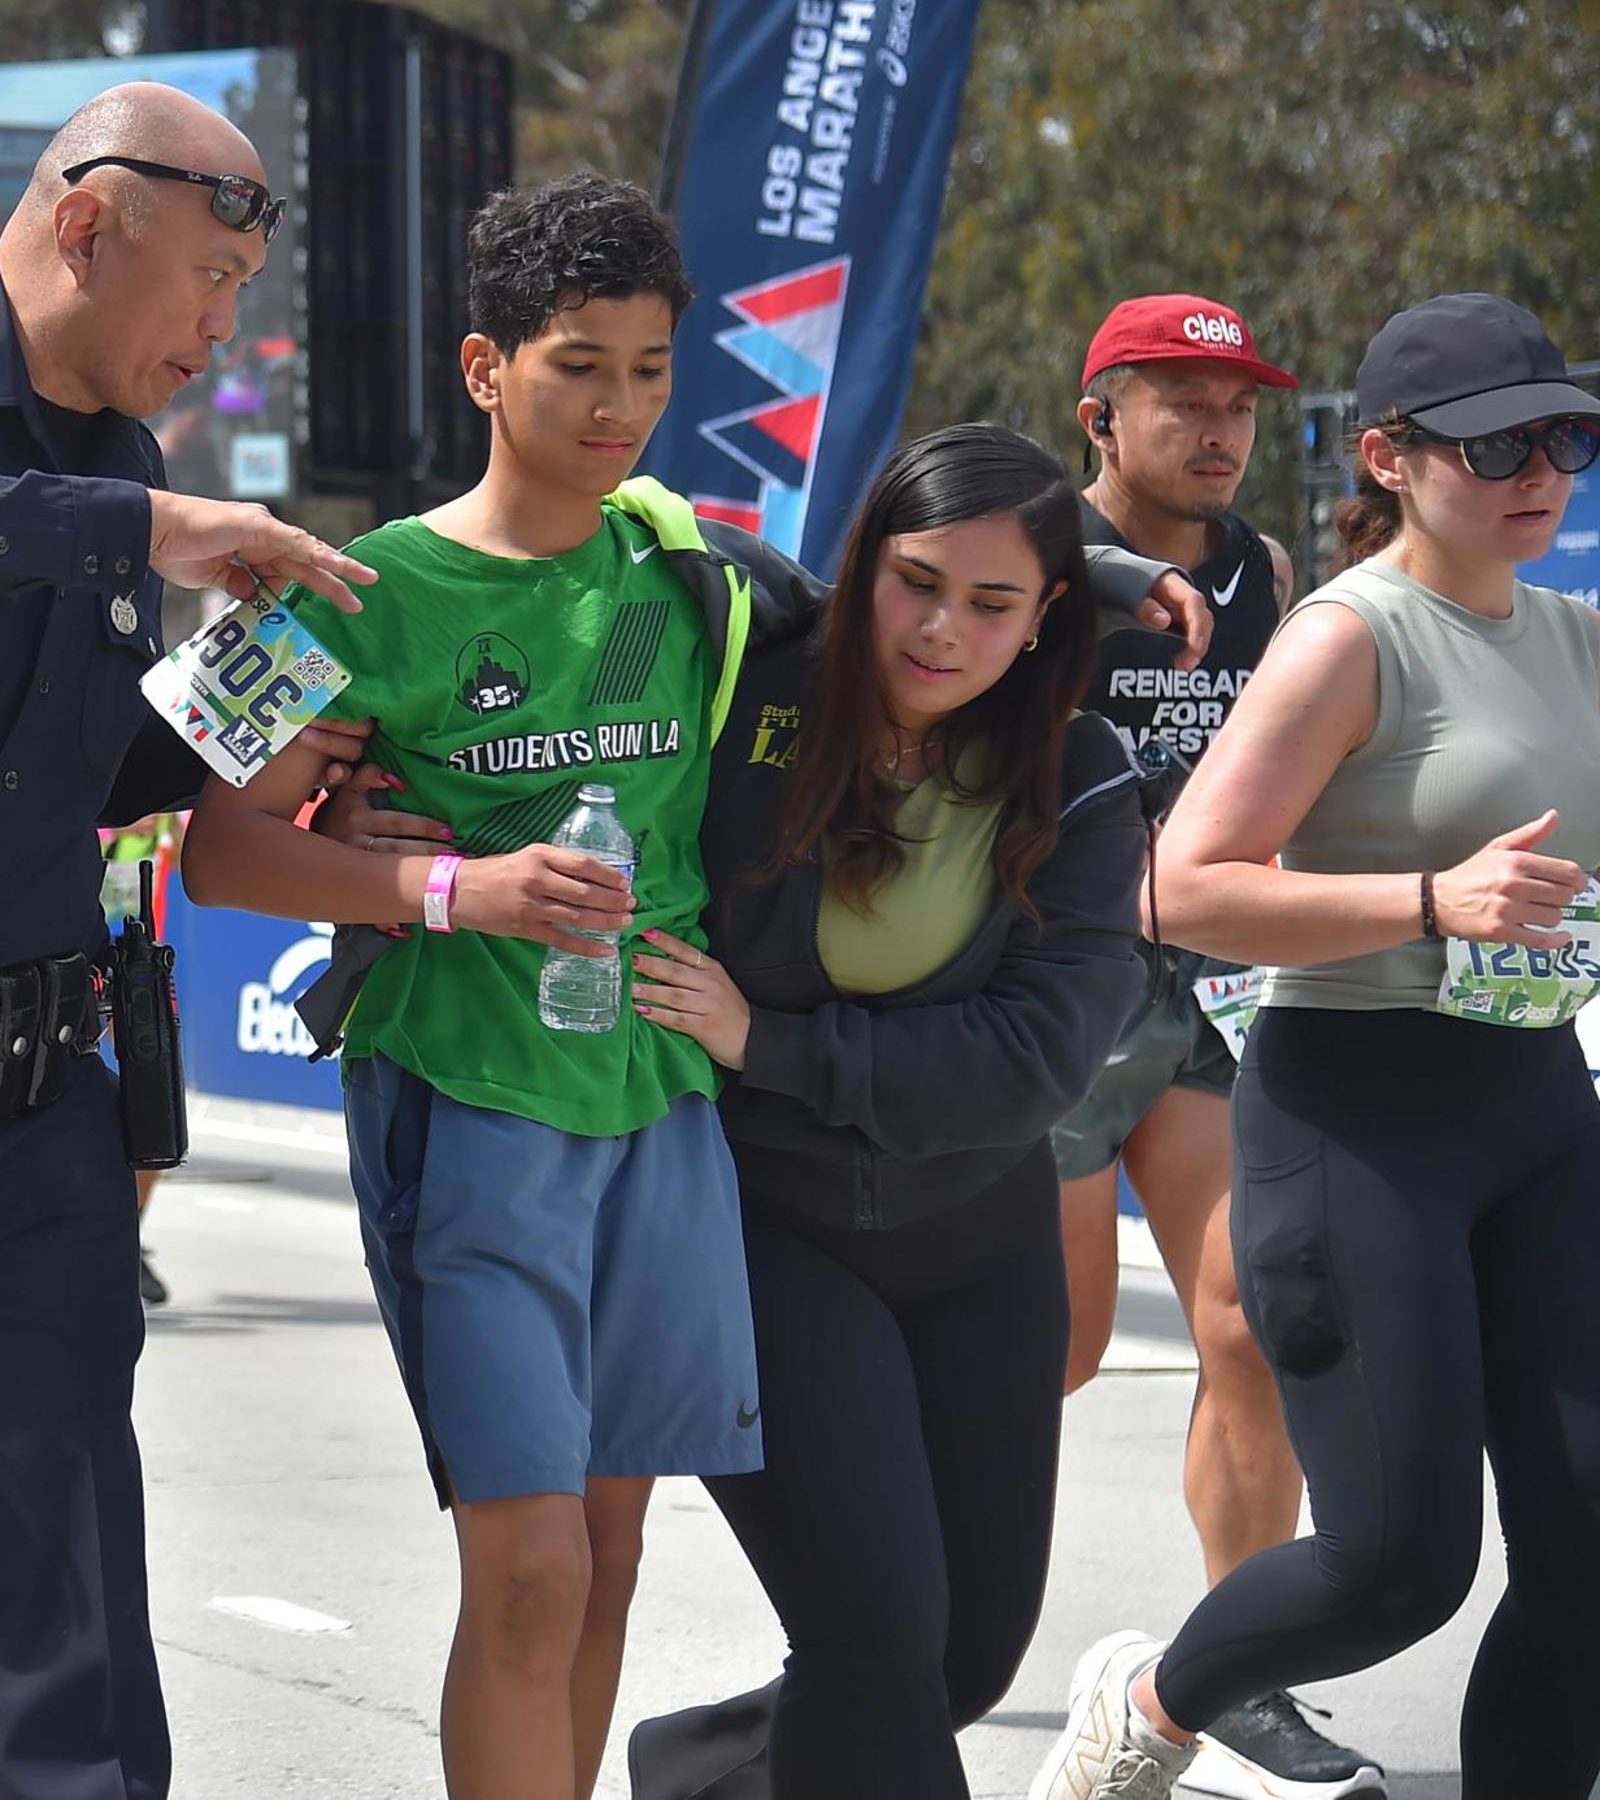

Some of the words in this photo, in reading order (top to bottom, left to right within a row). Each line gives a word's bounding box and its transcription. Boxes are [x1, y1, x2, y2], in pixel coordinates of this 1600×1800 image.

[793, 0, 877, 245] MARATH
[756, 144, 803, 238] LOS
[191, 614, 303, 728] 306
[479, 685, 511, 709] 35
[448, 730, 594, 774] STUDENTS
[598, 723, 644, 760] RUN
[651, 719, 680, 754] LA
[1152, 701, 1224, 727] FOR
